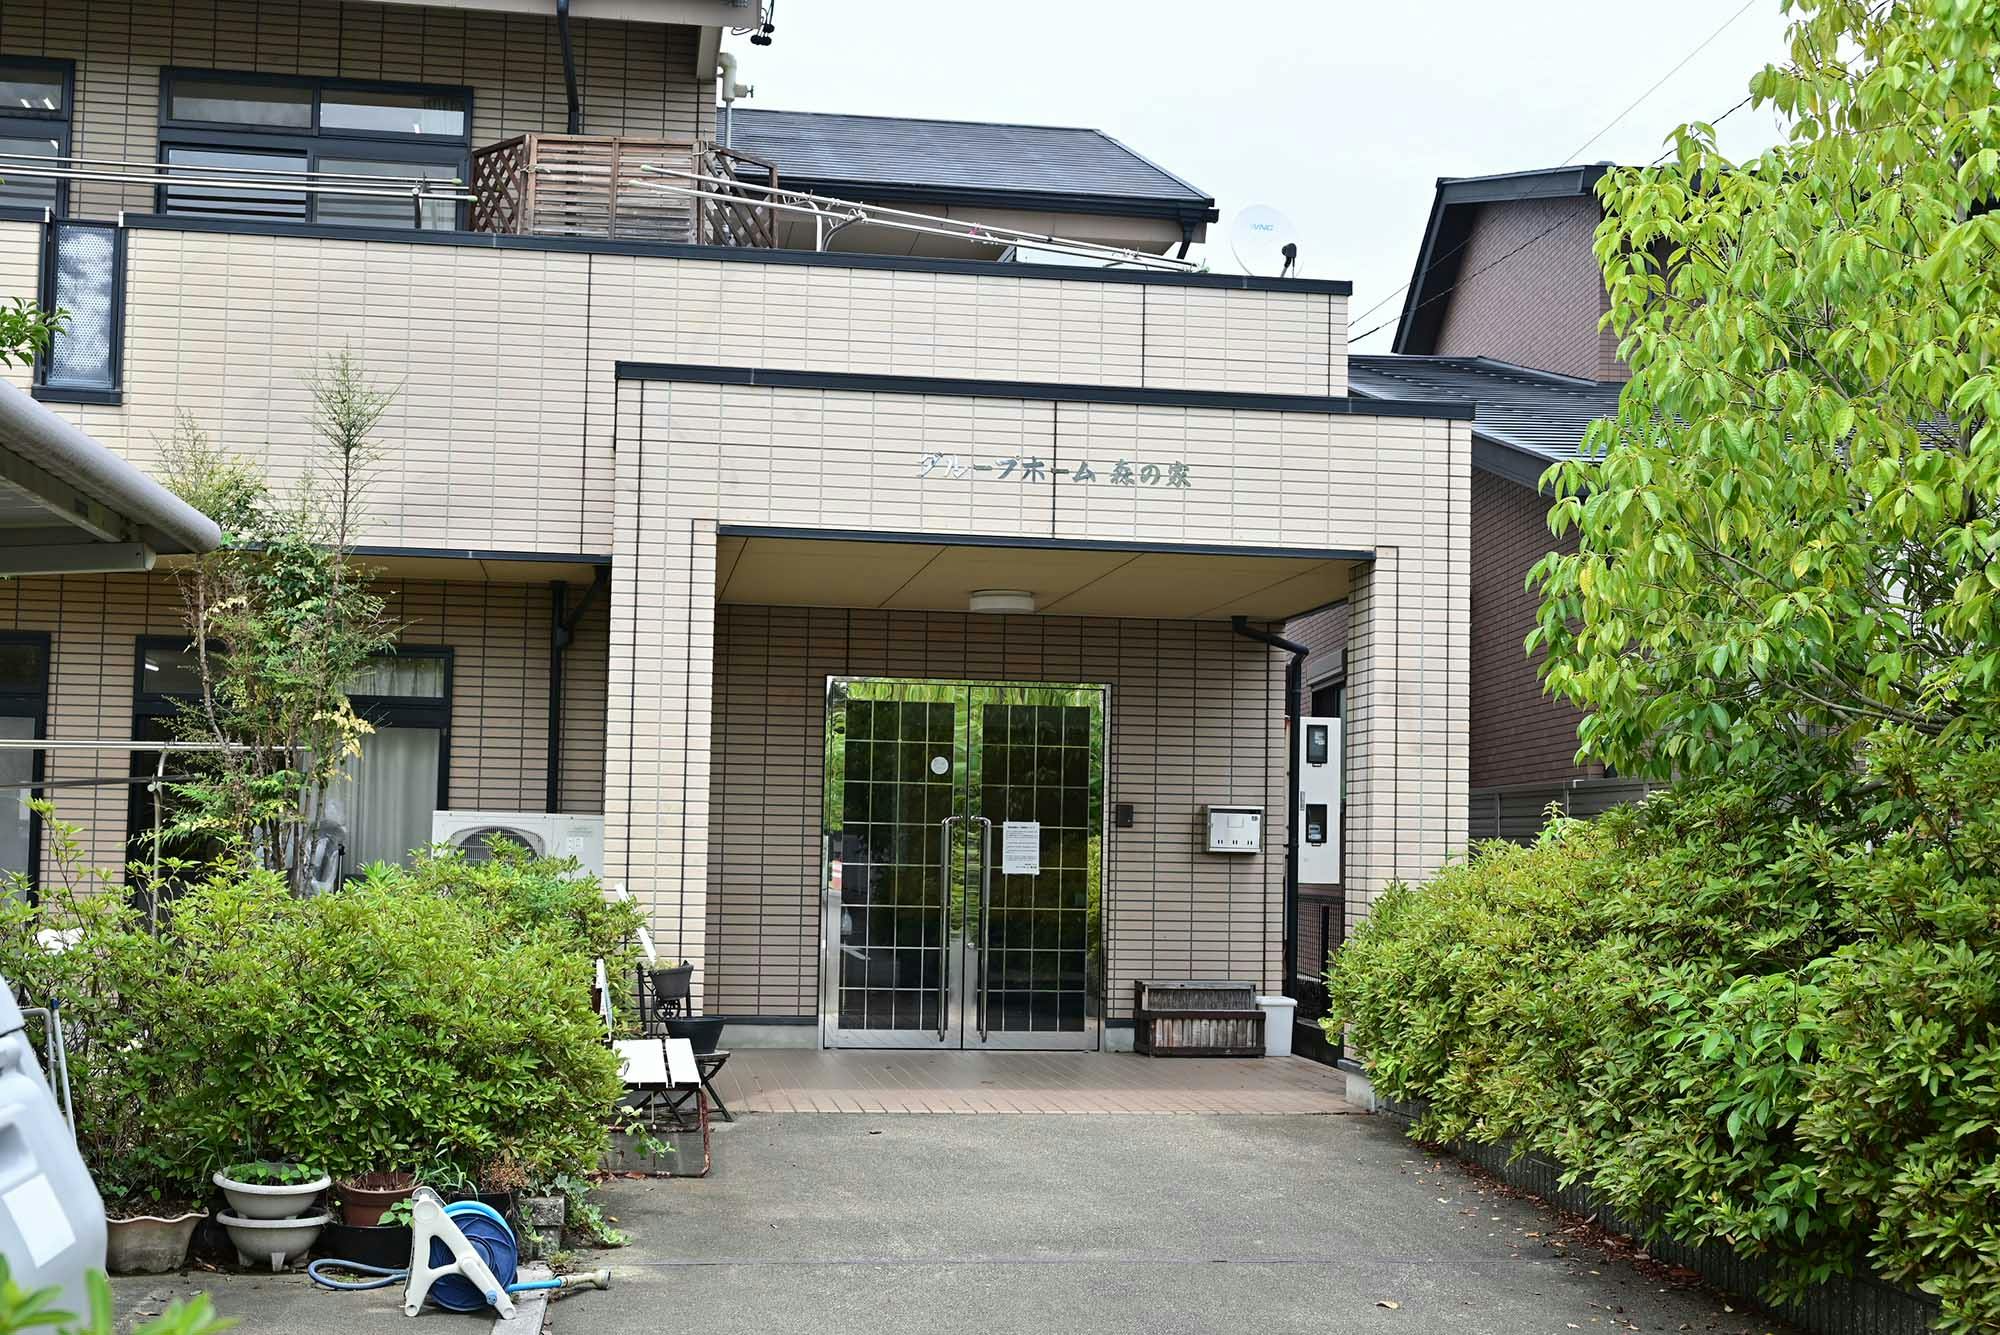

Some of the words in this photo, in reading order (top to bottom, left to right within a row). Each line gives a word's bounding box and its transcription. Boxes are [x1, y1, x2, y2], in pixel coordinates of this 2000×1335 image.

[917, 451, 1096, 483] グループホーム
[1110, 458, 1192, 488] 森の家
